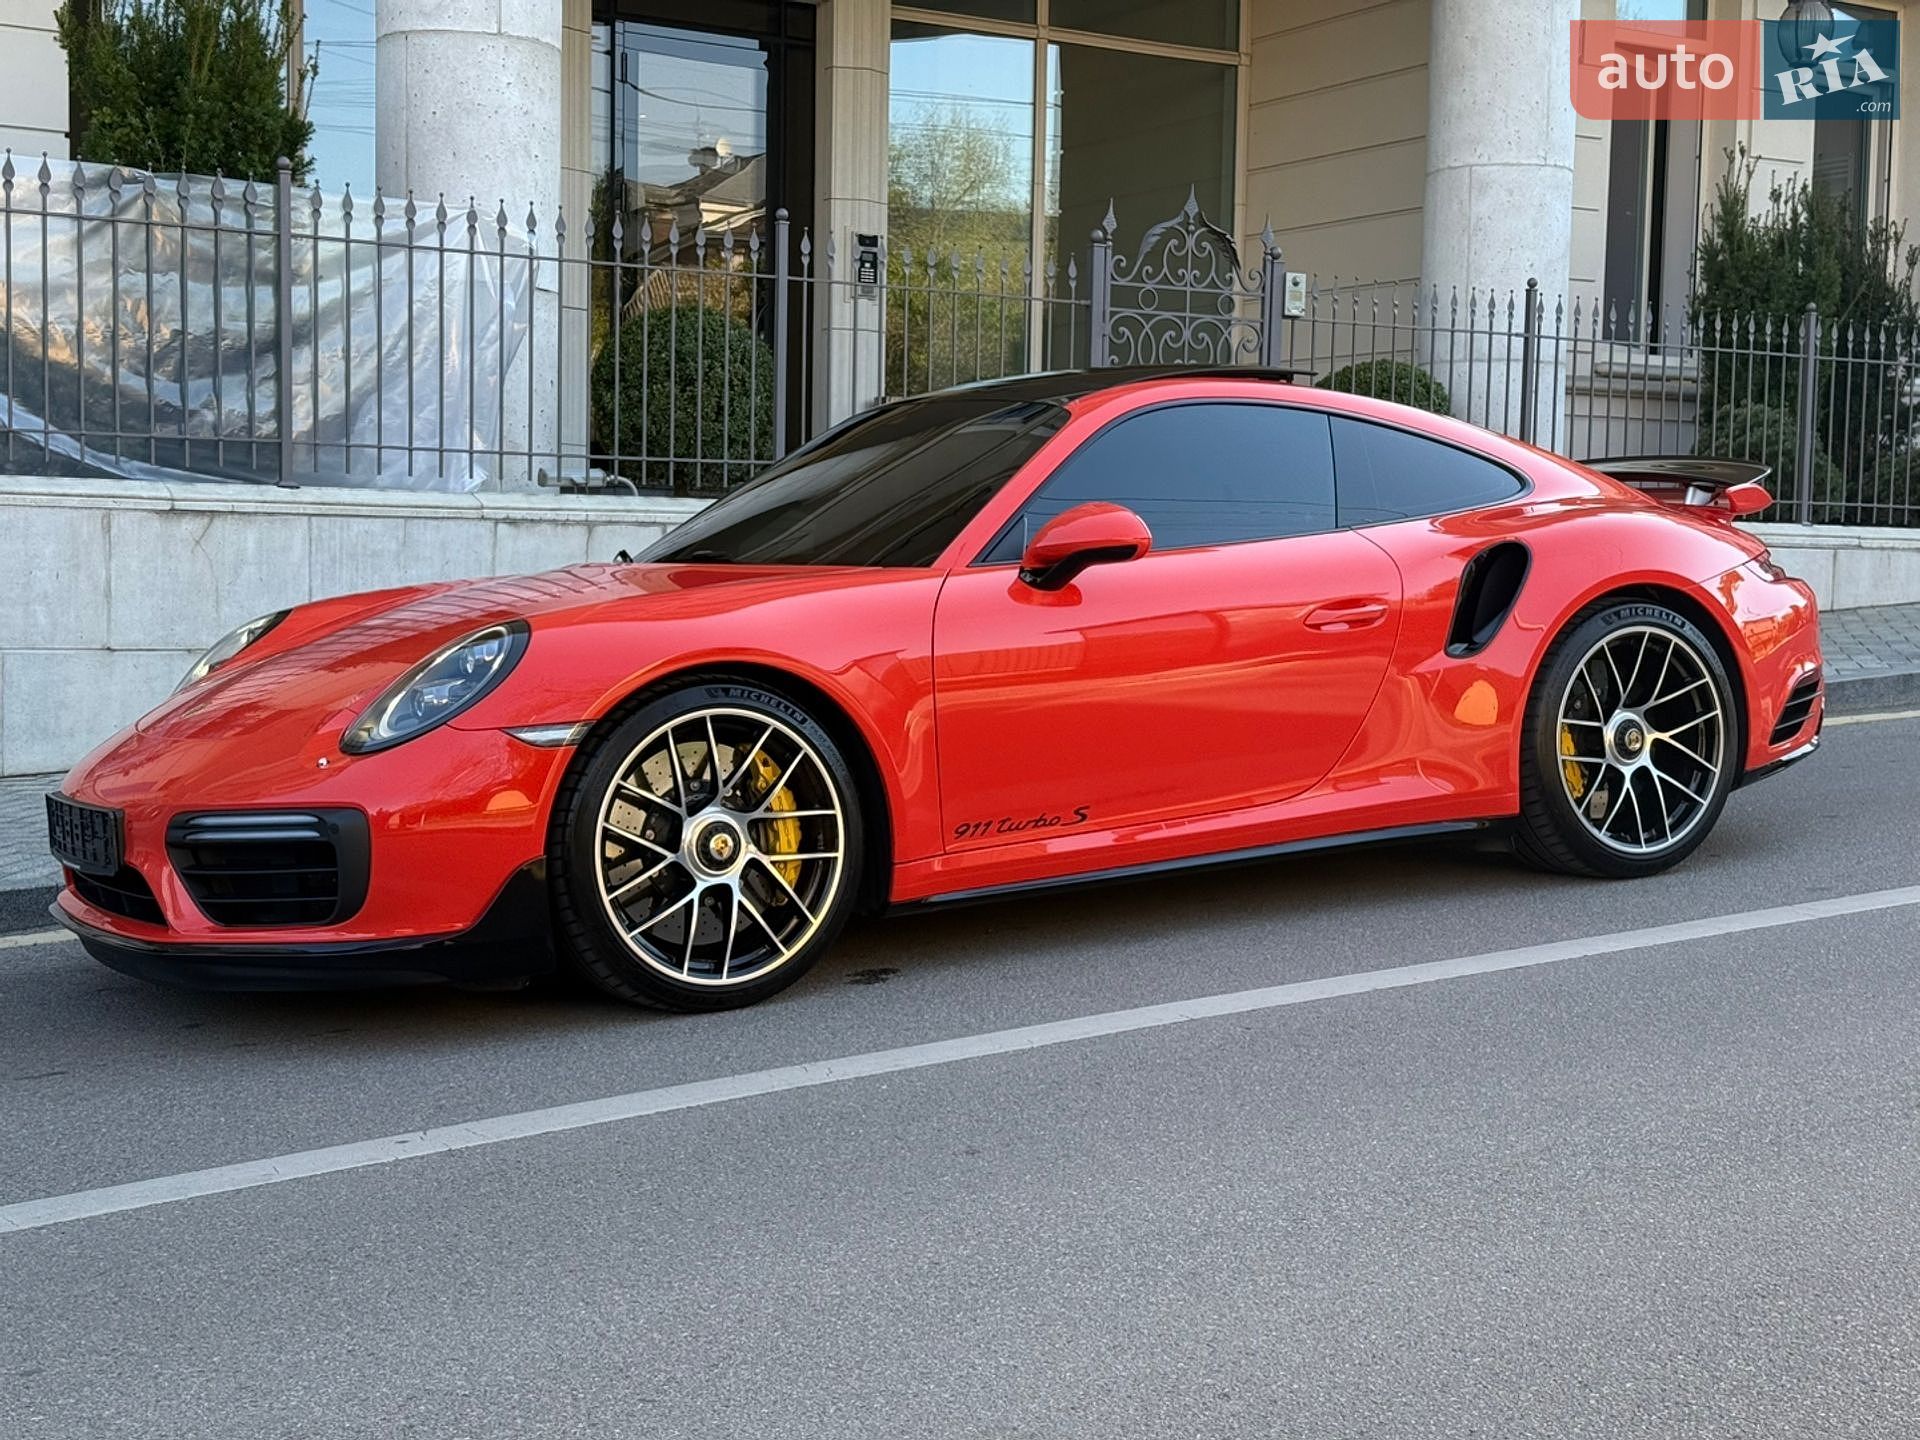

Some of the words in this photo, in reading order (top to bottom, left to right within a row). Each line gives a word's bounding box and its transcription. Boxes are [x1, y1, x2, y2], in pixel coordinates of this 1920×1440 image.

[1621, 607, 1683, 625] MICHELIN
[729, 687, 805, 723] MICHELIN
[954, 820, 993, 839] 911
[997, 812, 1061, 833] turbo
[1060, 805, 1090, 826] S
